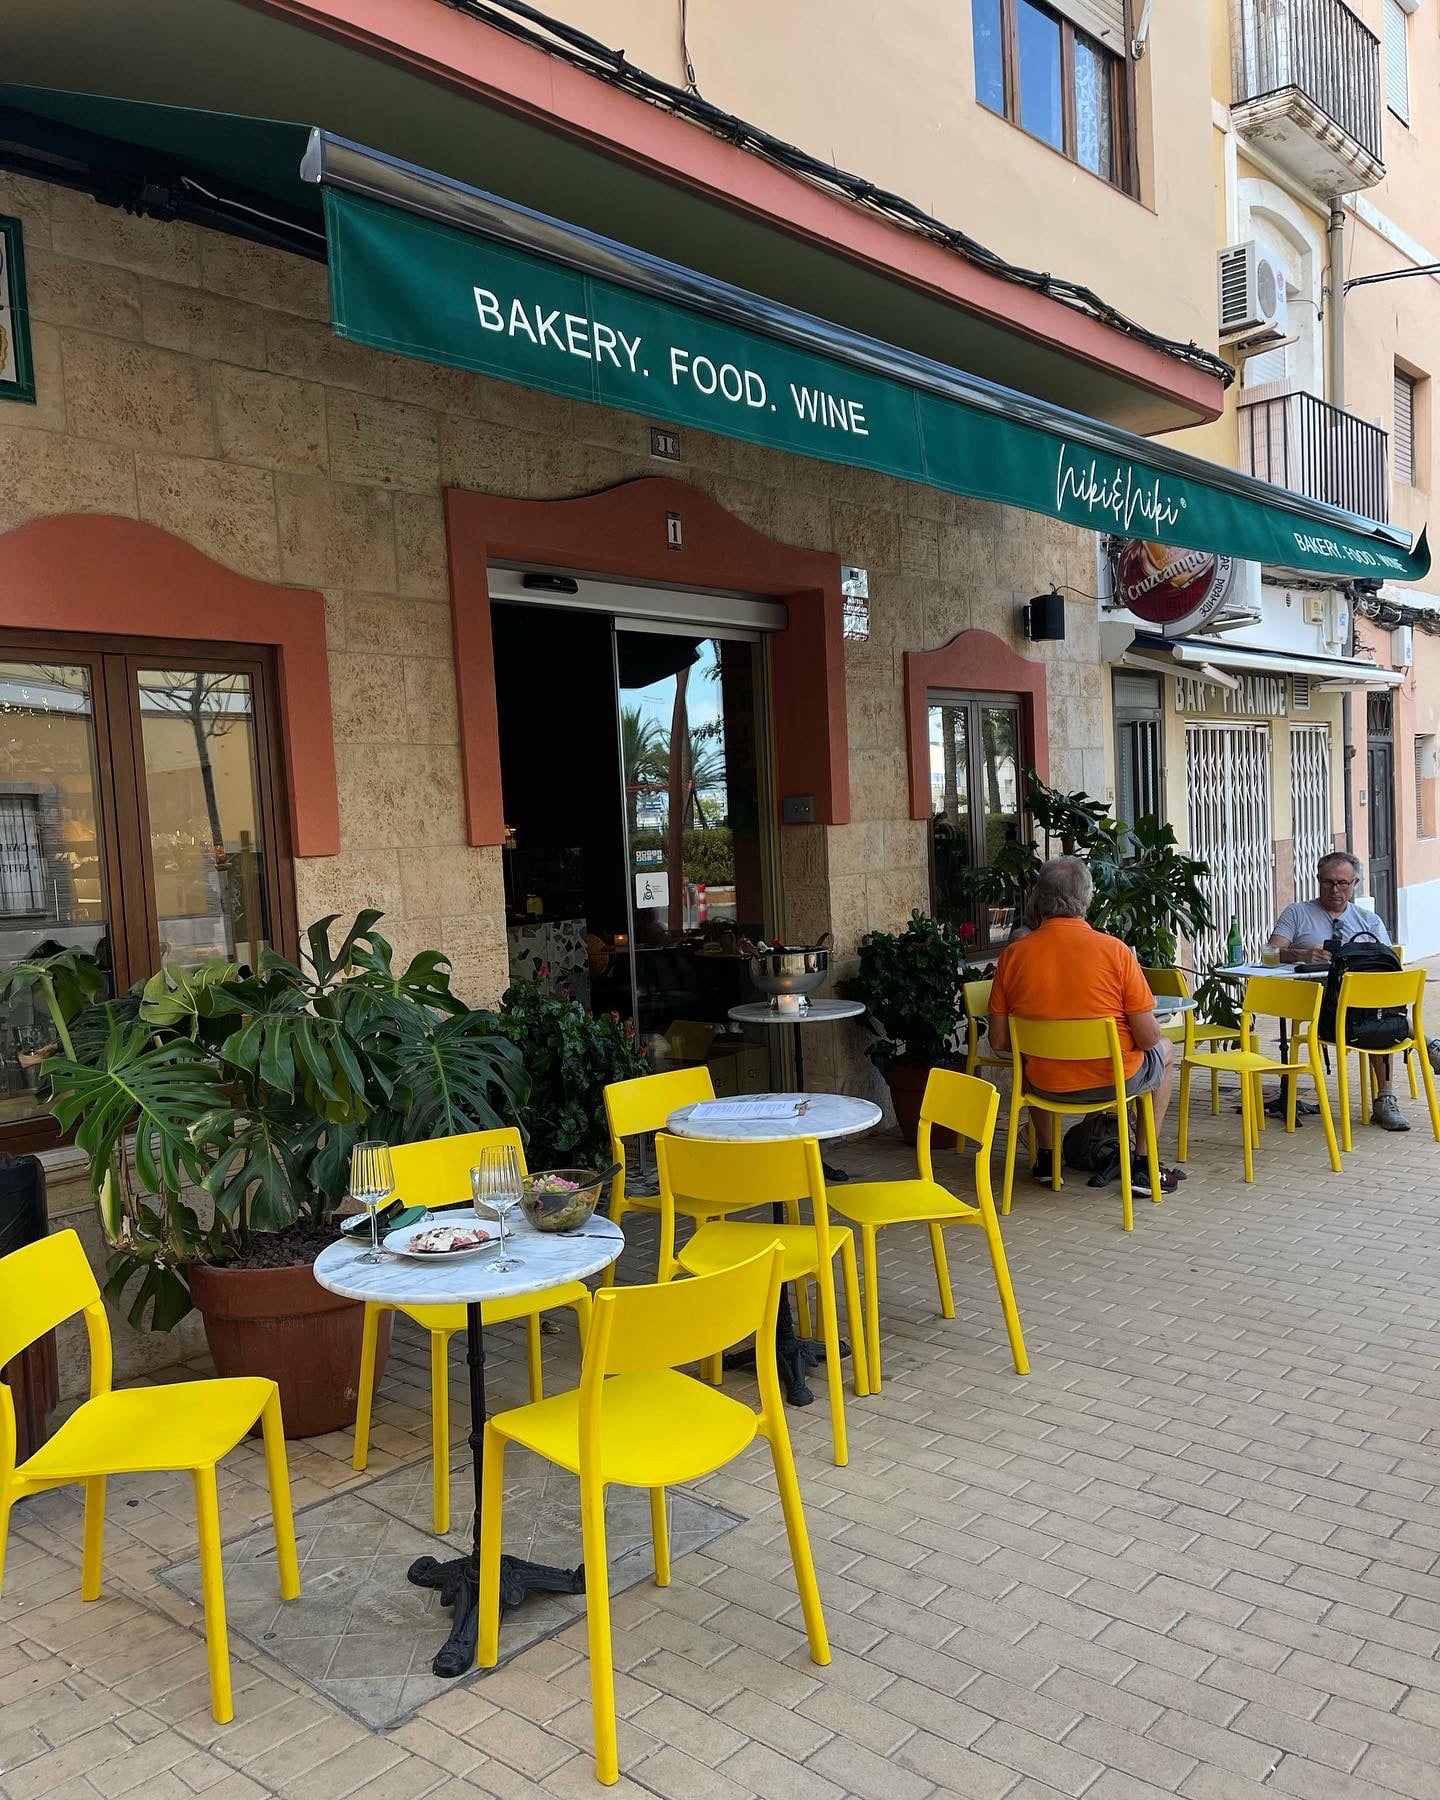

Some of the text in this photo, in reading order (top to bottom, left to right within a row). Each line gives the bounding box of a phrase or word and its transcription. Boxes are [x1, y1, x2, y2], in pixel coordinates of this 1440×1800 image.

[473, 286, 869, 436] BAKERY. FOOD. WINE
[671, 520, 679, 543] 1
[1293, 532, 1346, 560] BAKERY.
[1342, 545, 1381, 567] FOOD.
[1127, 551, 1206, 601] Cruzcampo
[1199, 578, 1226, 618] PIRAMIDE
[1175, 674, 1287, 716] BAR PIRAMIDE
